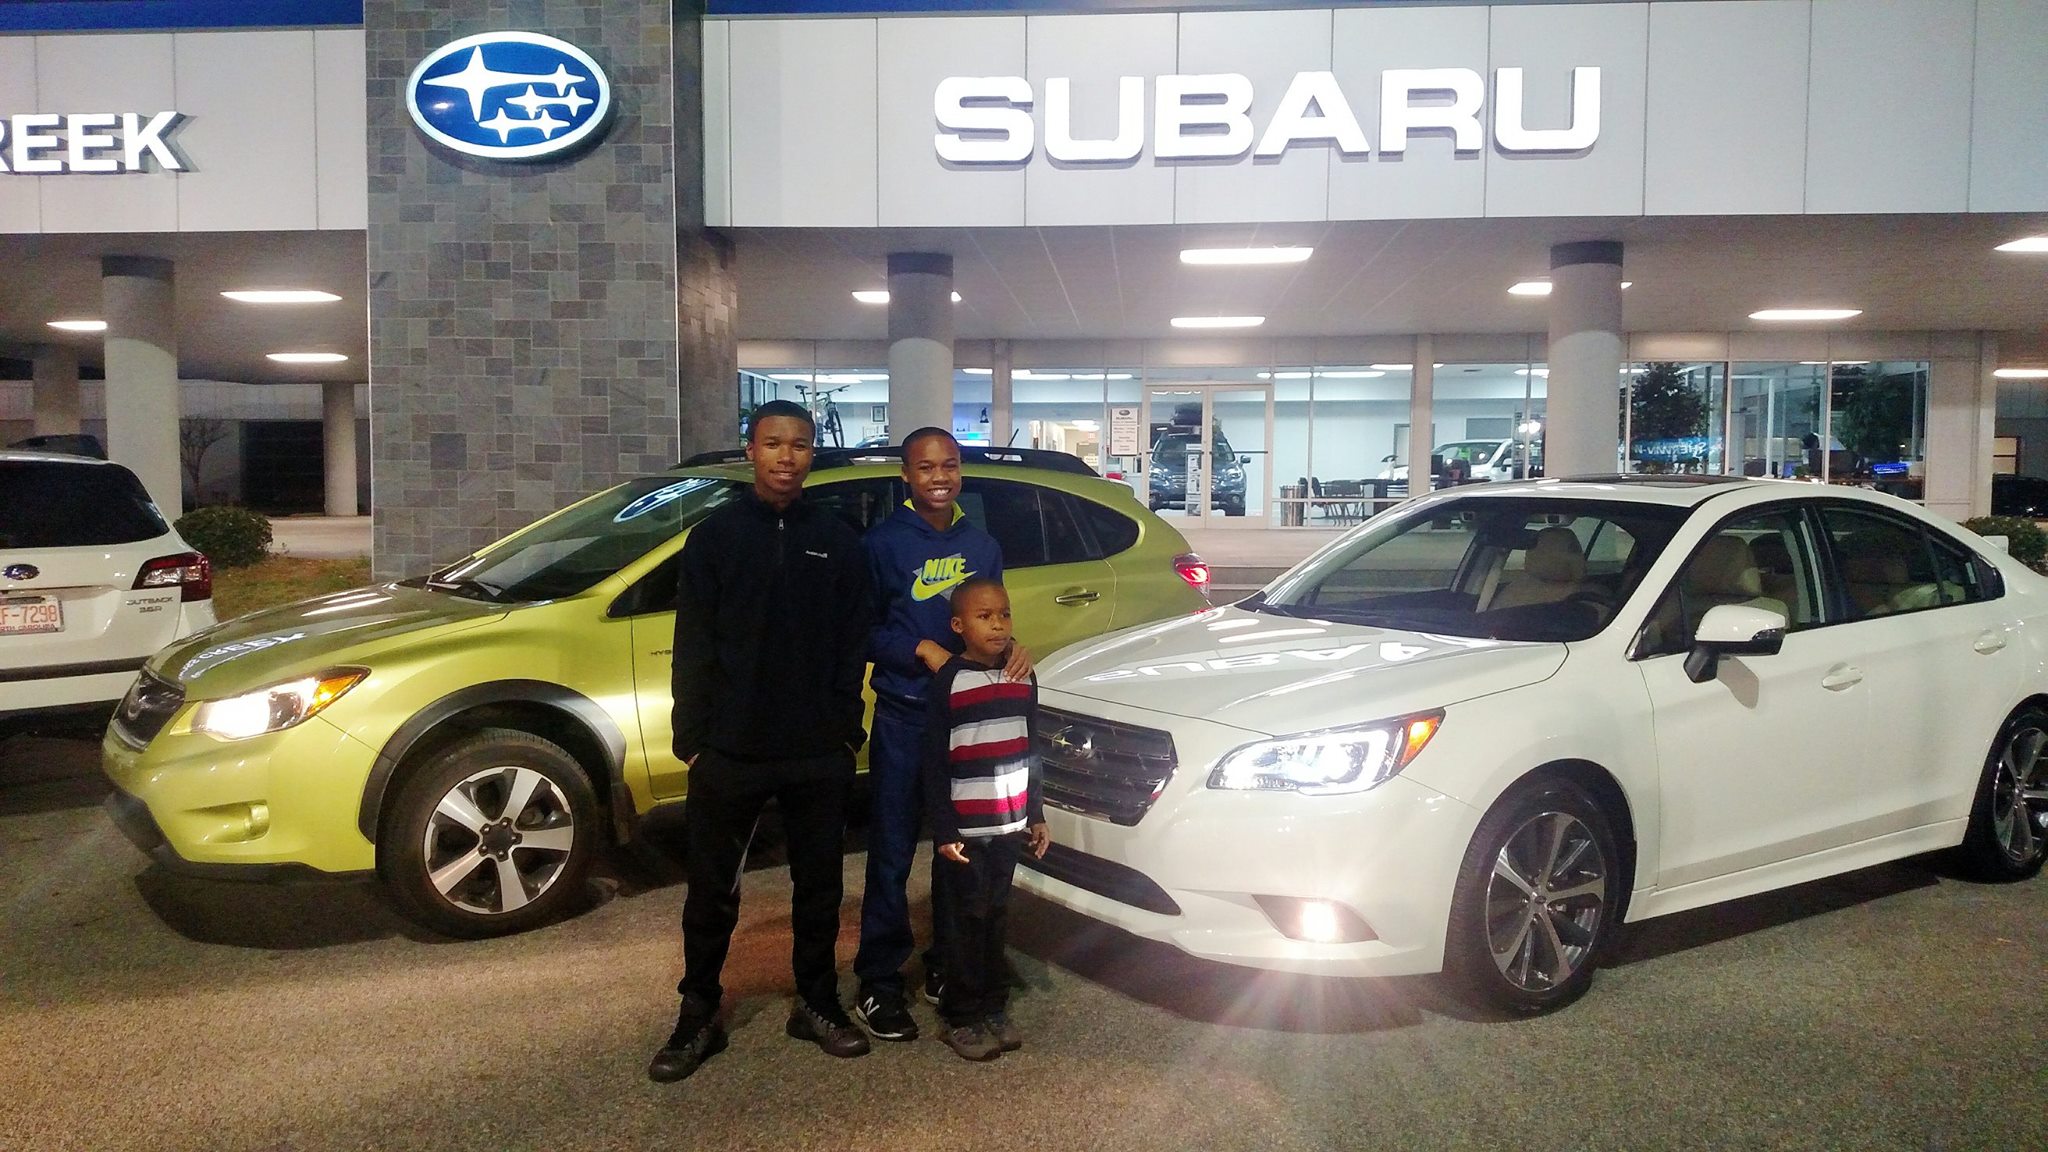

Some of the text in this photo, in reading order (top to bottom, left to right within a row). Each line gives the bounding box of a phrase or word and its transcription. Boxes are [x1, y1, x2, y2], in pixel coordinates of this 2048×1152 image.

[934, 66, 1601, 164] SUBARU
[0, 111, 181, 172] EEK
[922, 558, 967, 580] NIKE
[126, 596, 174, 606] OUTBACK
[0, 605, 57, 625] F-7298
